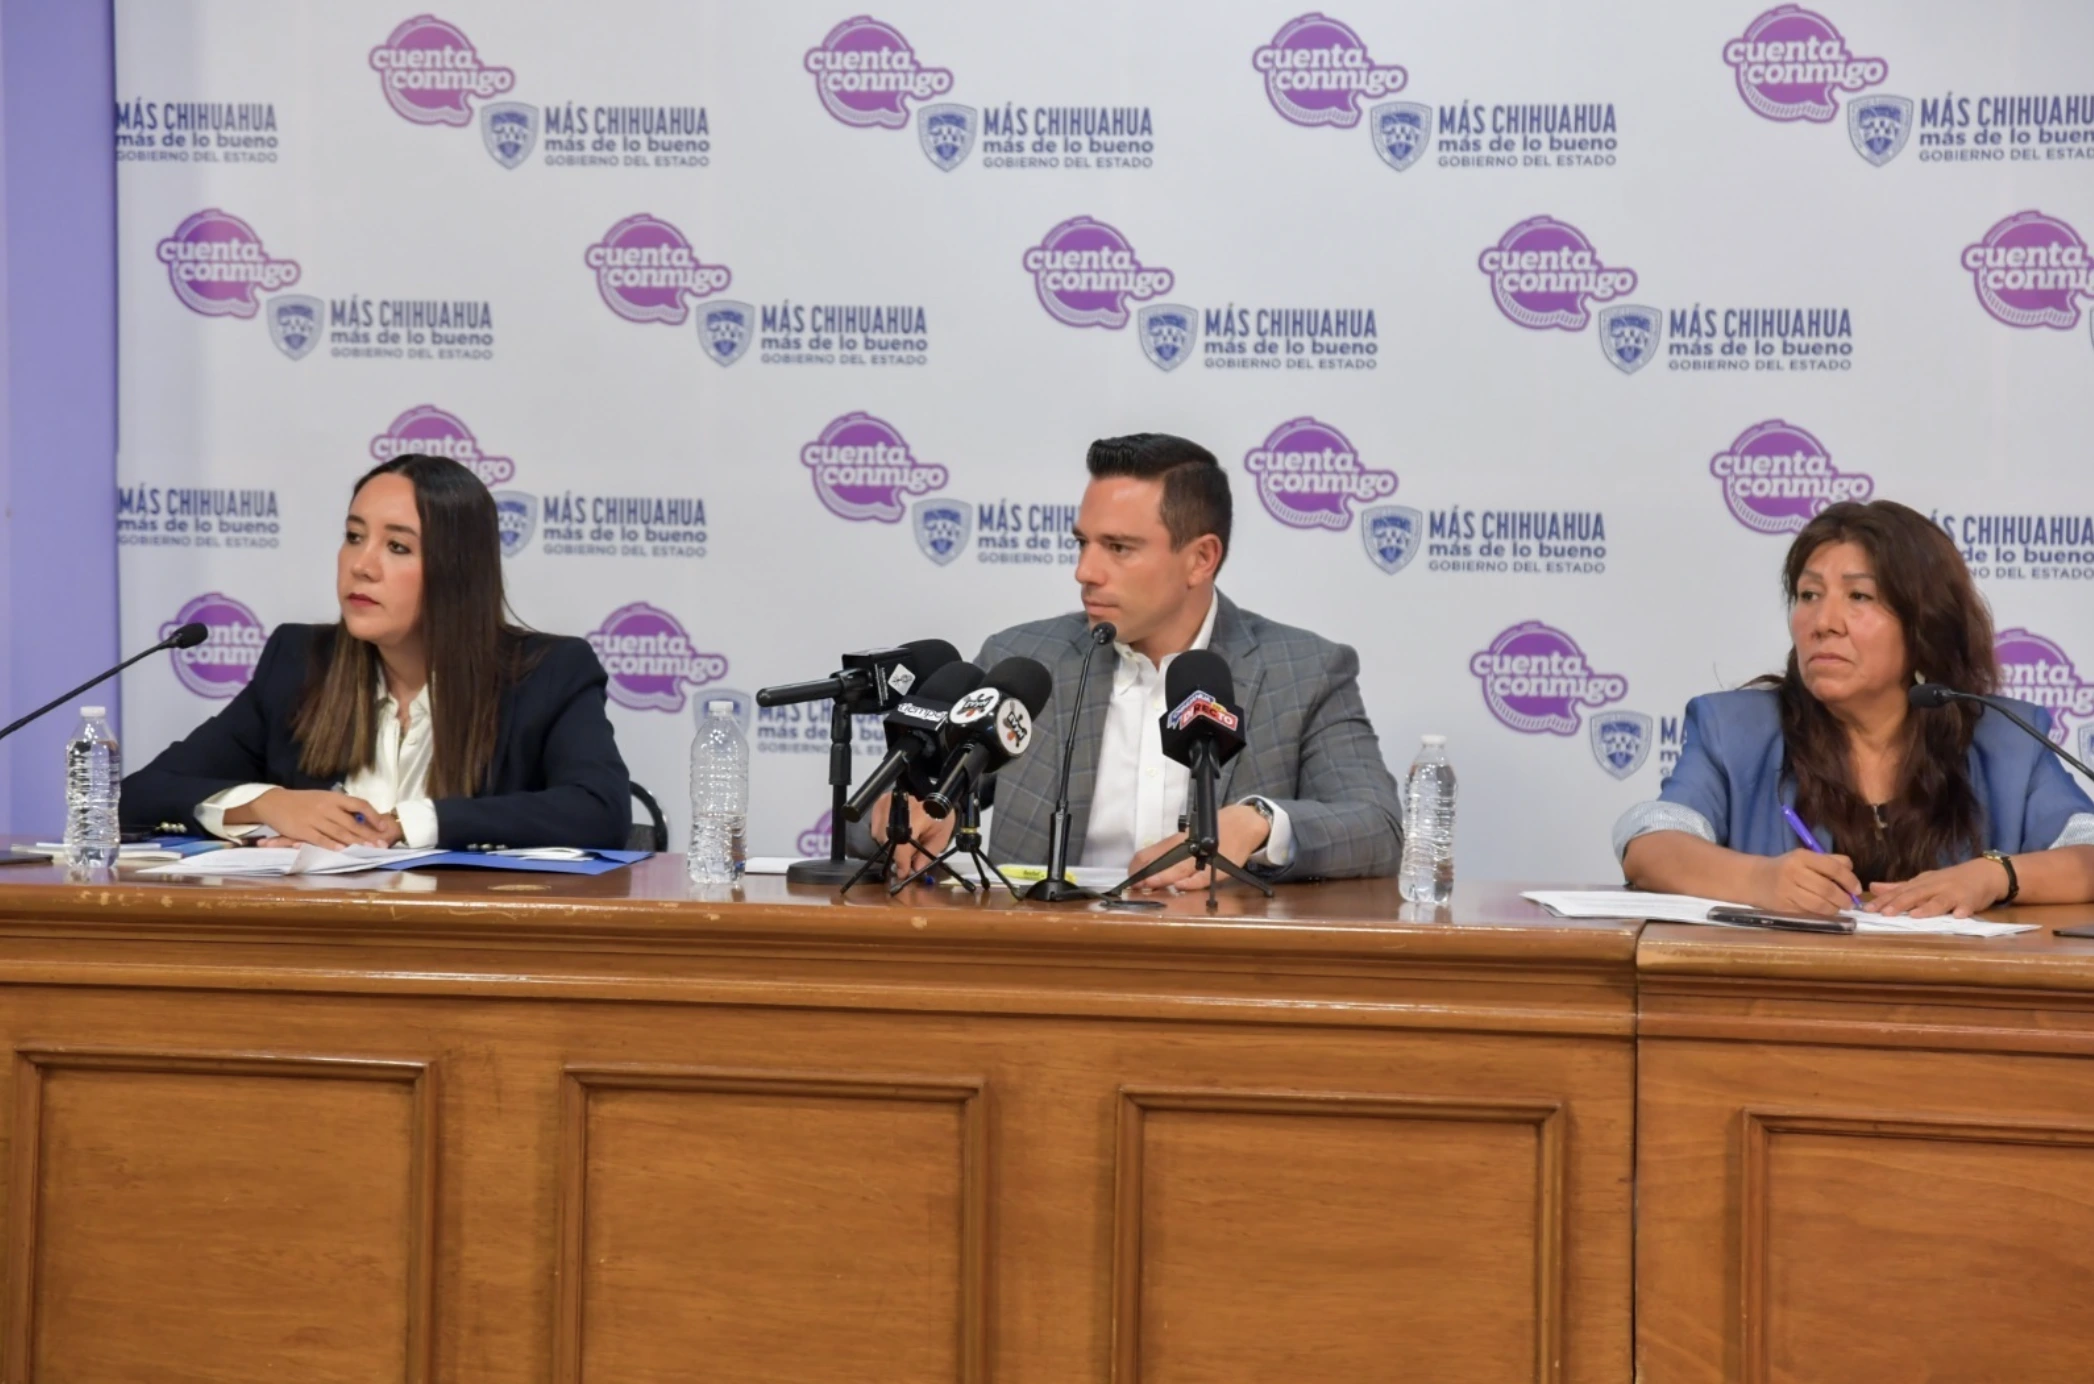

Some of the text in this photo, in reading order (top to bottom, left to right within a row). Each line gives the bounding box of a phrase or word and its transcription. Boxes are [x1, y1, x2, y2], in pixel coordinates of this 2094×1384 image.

[372, 44, 472, 68] cuenta
[806, 45, 909, 70] cuenta
[1255, 43, 1363, 68] cuenta
[1727, 36, 1839, 61] cuenta
[392, 66, 512, 95] conmigo
[827, 68, 950, 97] conmigo
[1276, 66, 1406, 96] conmigo
[1749, 59, 1884, 90] conmigo
[116, 96, 277, 132] MÁS CHIHUAHUA
[545, 101, 709, 136] MÁS CHIHUAHUA
[983, 101, 1153, 137] MÁS CHIHUAHUA
[1439, 99, 1617, 135] MÁS CHIHUAHUA
[1920, 91, 2094, 128] MÁS CHIHUAHU
[116, 132, 278, 148] más de lo bueno
[544, 137, 710, 153] más de lo bueno
[983, 138, 1154, 154] más de lo bueno
[1438, 135, 1618, 152] más de lo bueno
[1919, 127, 2094, 146] más de lo buen
[192, 150, 218, 162] DEL
[223, 150, 278, 162] ESTADO
[544, 155, 710, 167] GOBIERNO DEL ESTADO
[983, 157, 1153, 169] GOBIERNO DEL ESTADO
[1437, 155, 1616, 167] GOBIERNO DEL ESTADO
[1918, 148, 2040, 161] GOBIERNO DEL
[158, 237, 258, 261] cuenta
[588, 243, 689, 266] cuenta
[1025, 245, 1130, 270] cuenta
[1481, 245, 1591, 270] cuenta
[1966, 241, 2080, 267] cuenta
[178, 259, 298, 287] conmigo
[608, 264, 729, 293] conmigo
[1046, 268, 1172, 297] conmigo
[1503, 268, 1635, 298] conmigo
[331, 294, 492, 329] MÁS CHIHUAHUA
[761, 299, 927, 335] MÁS CHIHUAHUA
[1204, 302, 1377, 339] MÁS CHIHUAHUA
[1669, 302, 1852, 339] MÁS CHIHUAHUA
[331, 329, 494, 345] más de lo bueno
[761, 335, 928, 352] más de lo bueno
[1204, 339, 1378, 356] más de lo bueno
[1668, 340, 1853, 356] más de lo bueno
[331, 347, 493, 359] GOBIERNO DEL ESTADO
[760, 354, 928, 365] GOBIERNO DEL ESTADO
[1204, 358, 1377, 369] GOBIERNO DEL ESTADO
[1668, 359, 1852, 371] GOBIERNO DEL ESTADO
[373, 434, 472, 457] cuenta
[803, 441, 905, 465] cuenta
[1246, 447, 1352, 471] cuenta
[1714, 450, 1825, 475] cuenta
[824, 463, 946, 491] conmigo
[1268, 469, 1395, 499] conmigo
[1736, 473, 1869, 503] conmigo
[117, 483, 279, 518] MÁS CHIHUAHUA
[543, 490, 707, 527] MÁS CHIHUAHUA
[117, 517, 280, 534] más de lo bueno
[978, 498, 1023, 534] MÁS
[1429, 504, 1605, 542] MÁS CHIHUAHUA
[194, 535, 220, 548] DEL
[225, 535, 279, 548] ESTADO
[543, 526, 708, 543] más de lo bueno
[978, 534, 1076, 550] más de lo
[1962, 515, 2094, 546] CHIHUAHUA
[543, 544, 707, 557] GOBIERNO DEL ESTADO
[977, 552, 1054, 564] GOBIERNO
[1428, 541, 1606, 558] más de lo bueno
[1960, 547, 2094, 564] de lo bueno
[1428, 560, 1605, 573] GOBIERNO DEL ESTADO
[1995, 567, 2026, 579] DEL
[2031, 567, 2094, 579] ESTADO
[587, 631, 685, 654] cuenta
[607, 652, 724, 681] conmigo
[1473, 651, 1581, 675] cuenta
[1494, 673, 1624, 703] conmigo
[758, 722, 829, 739] más de
